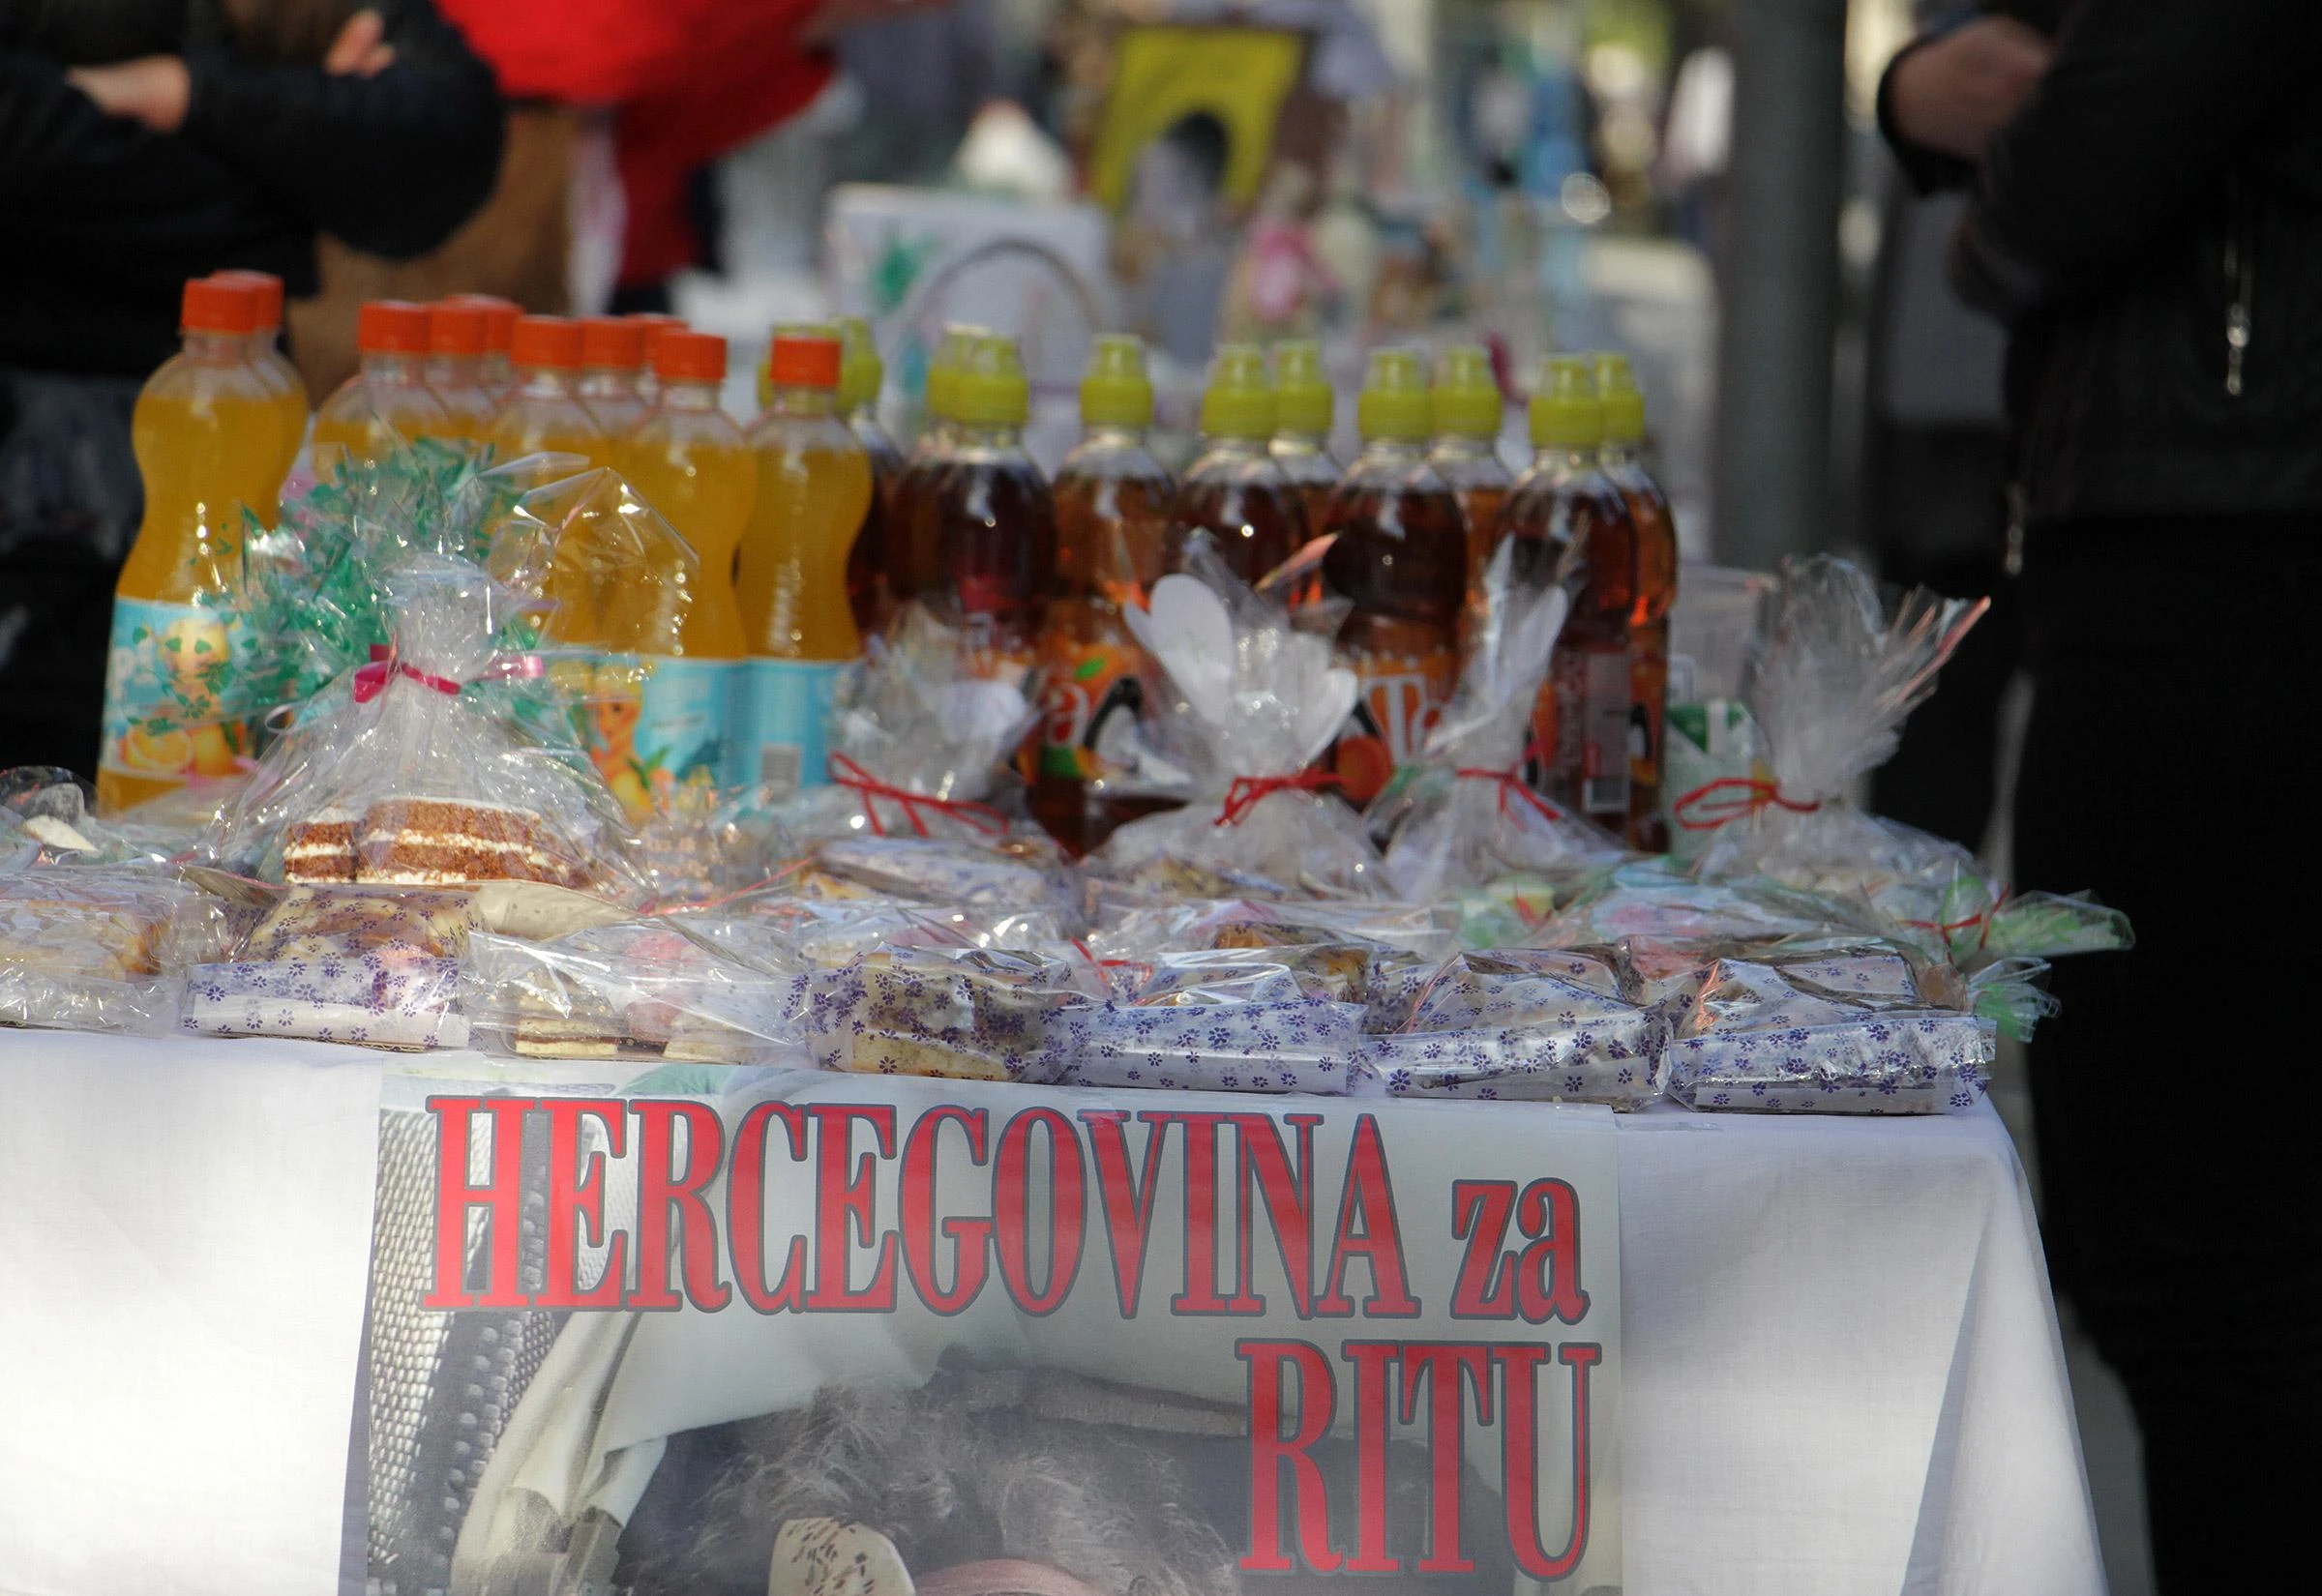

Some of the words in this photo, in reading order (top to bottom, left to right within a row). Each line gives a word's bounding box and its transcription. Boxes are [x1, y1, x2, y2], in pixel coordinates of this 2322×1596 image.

[420, 1095, 1422, 1319] HERCEGOVINA
[1449, 1177, 1592, 1324] za
[1234, 1337, 1602, 1582] RITU
